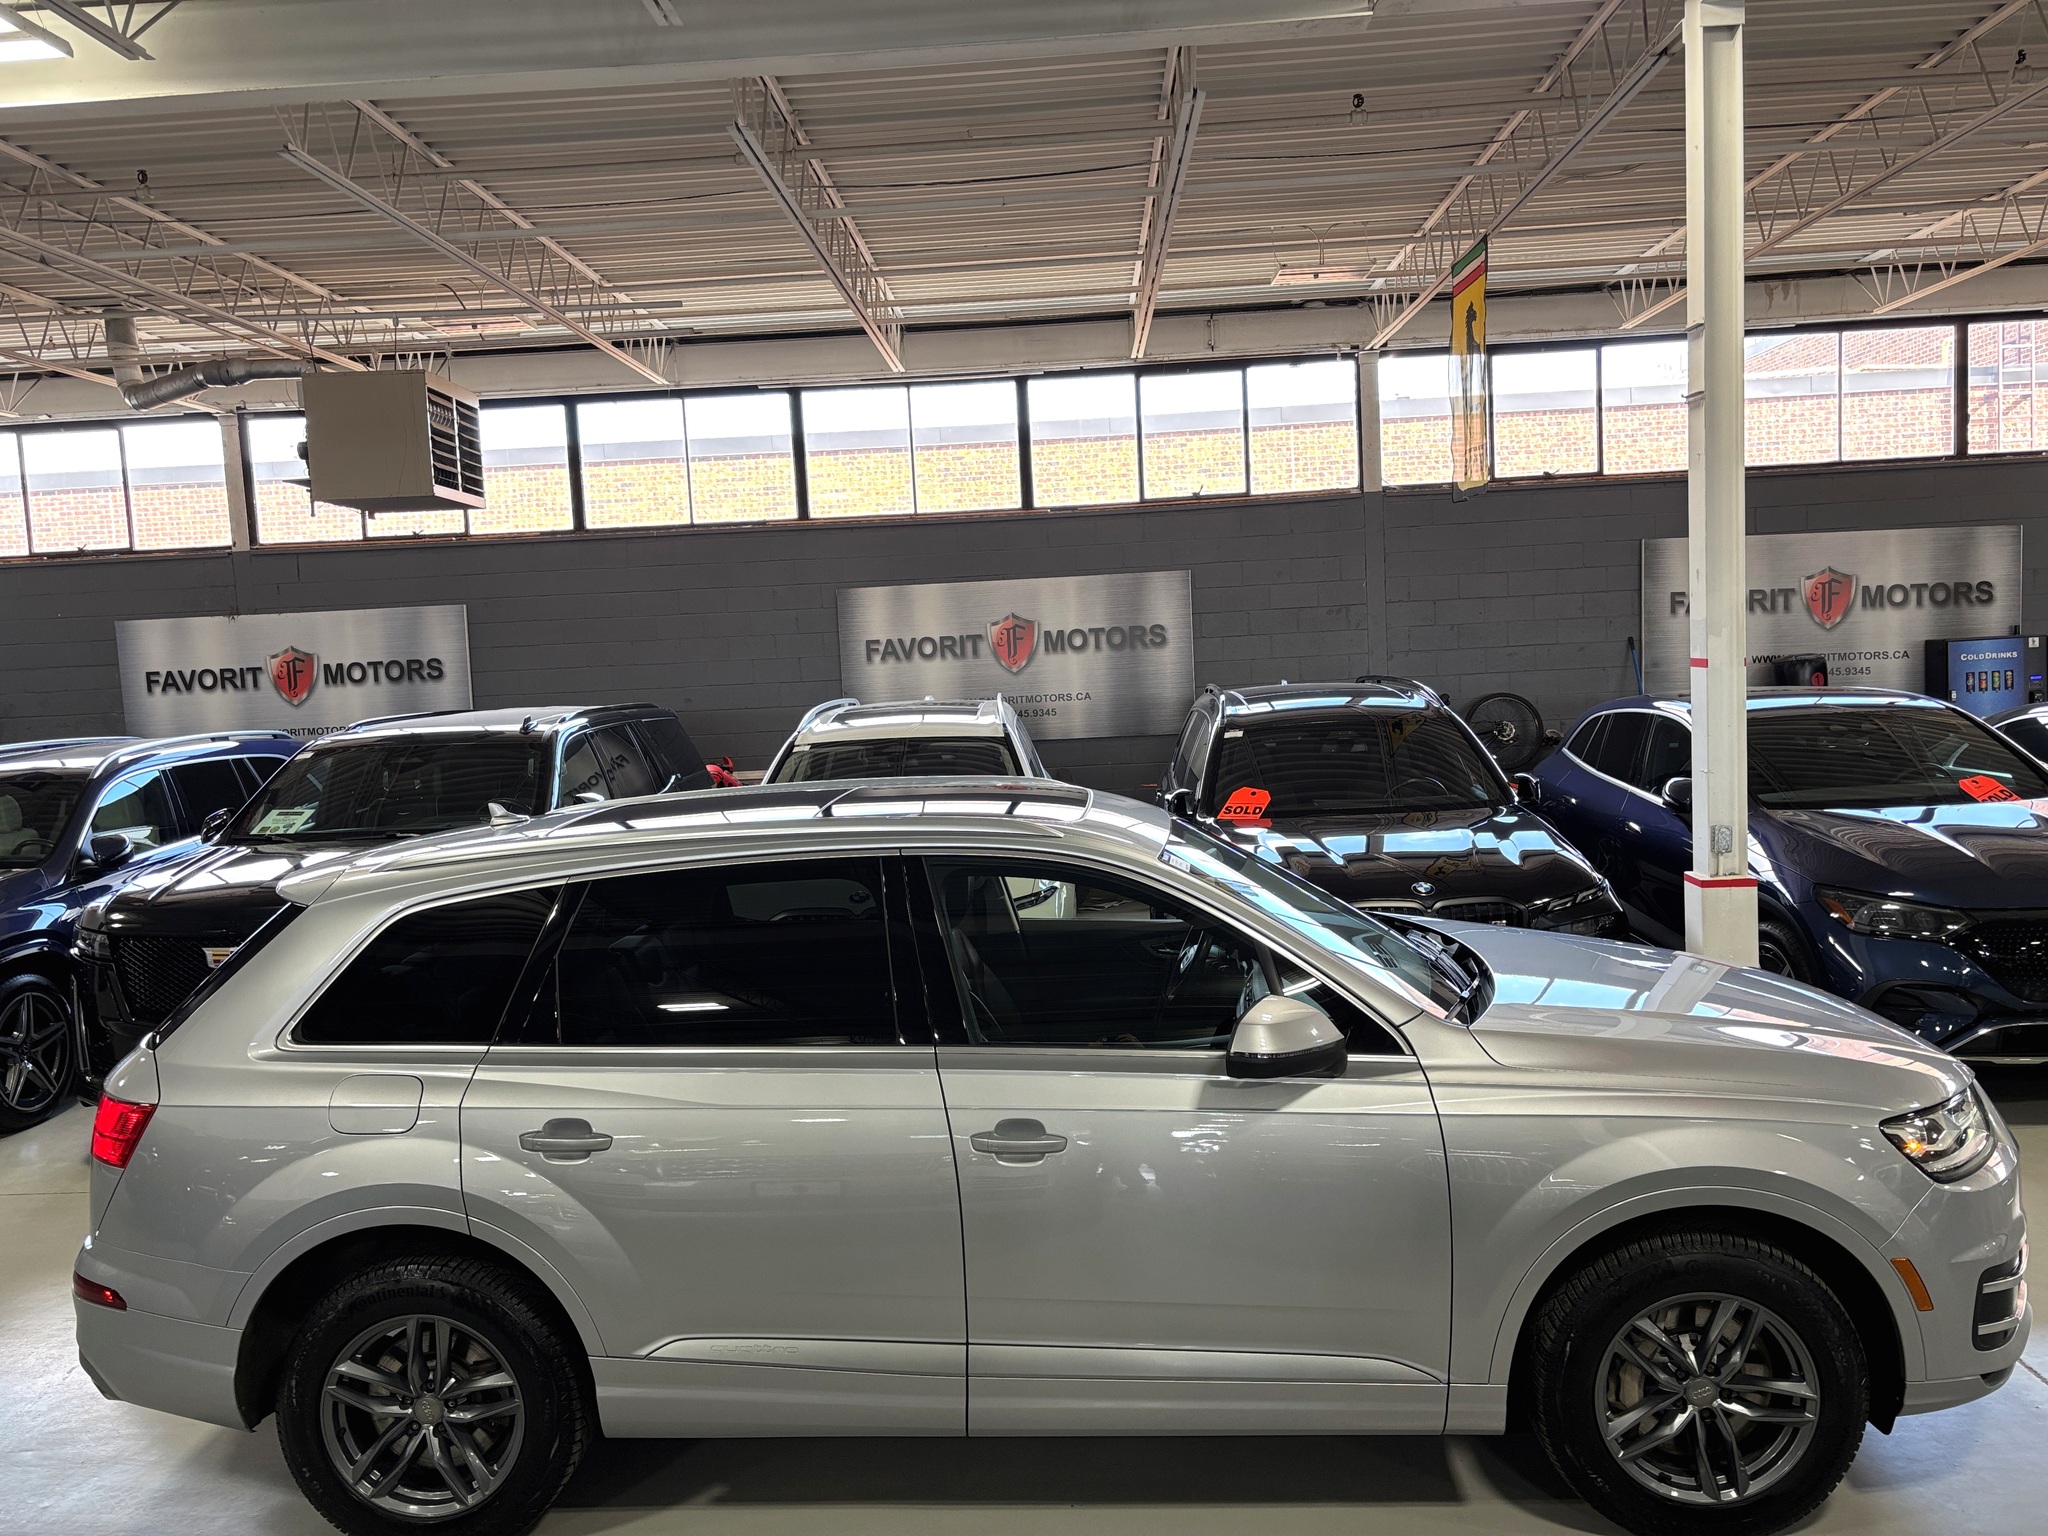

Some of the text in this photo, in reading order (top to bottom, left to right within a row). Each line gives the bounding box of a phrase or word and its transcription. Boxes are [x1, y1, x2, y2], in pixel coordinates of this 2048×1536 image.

[1670, 588, 1796, 614] FRIT
[1861, 581, 1994, 608] MOTORS
[865, 634, 983, 662] FAVORIT
[1043, 624, 1167, 653] MOTORS
[1985, 651, 2018, 660] DRINKS
[145, 667, 263, 693] FAVORIT
[323, 658, 444, 685] MOTORS
[1828, 667, 1872, 677] 45.9345
[1016, 708, 1057, 719] 45.9345
[1222, 805, 1264, 815] SOLD
[710, 1343, 799, 1354] quattro
